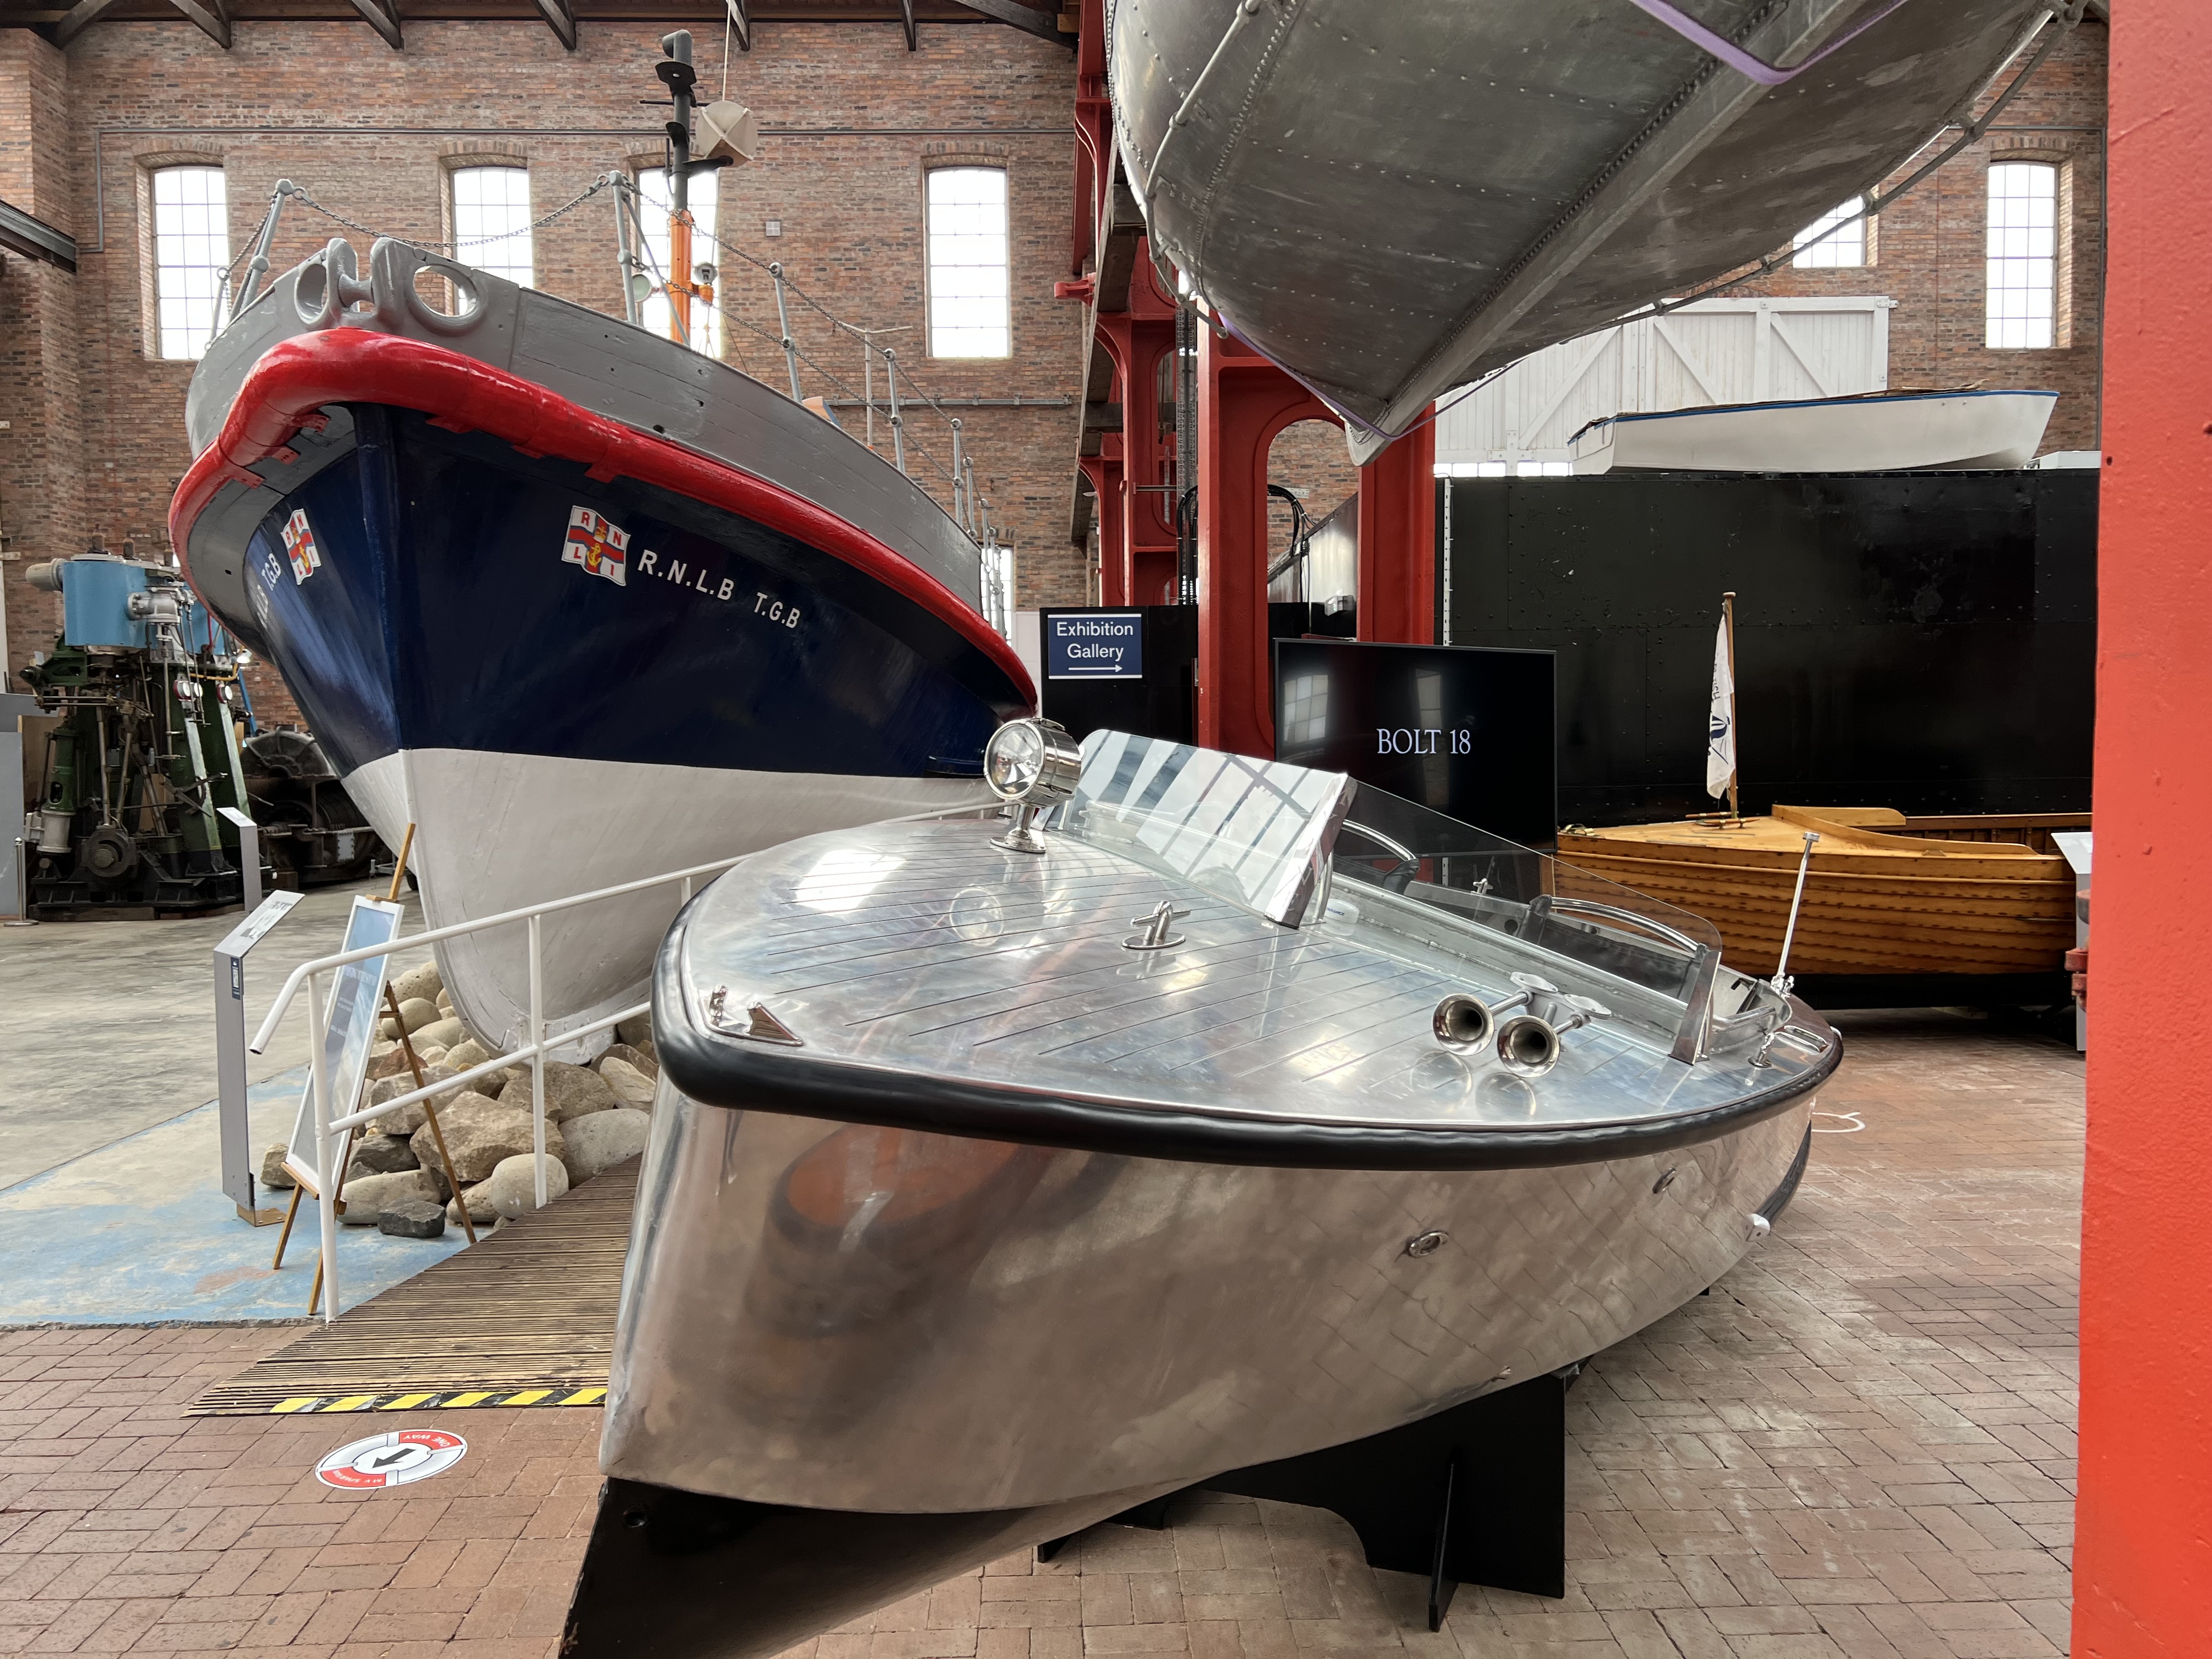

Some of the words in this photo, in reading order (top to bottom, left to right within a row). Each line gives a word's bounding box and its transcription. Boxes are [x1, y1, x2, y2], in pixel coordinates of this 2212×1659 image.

[581, 512, 590, 527] R
[613, 531, 622, 546] N
[573, 546, 582, 559] L
[610, 563, 614, 577] I
[637, 549, 735, 601] R.N.L.B
[754, 592, 800, 629] T.G.B
[1056, 621, 1133, 636] Exhibition
[1066, 643, 1124, 662] Gallery
[1376, 728, 1442, 755] BOLT
[1449, 729, 1471, 755] 18
[431, 1436, 450, 1448] ONE
